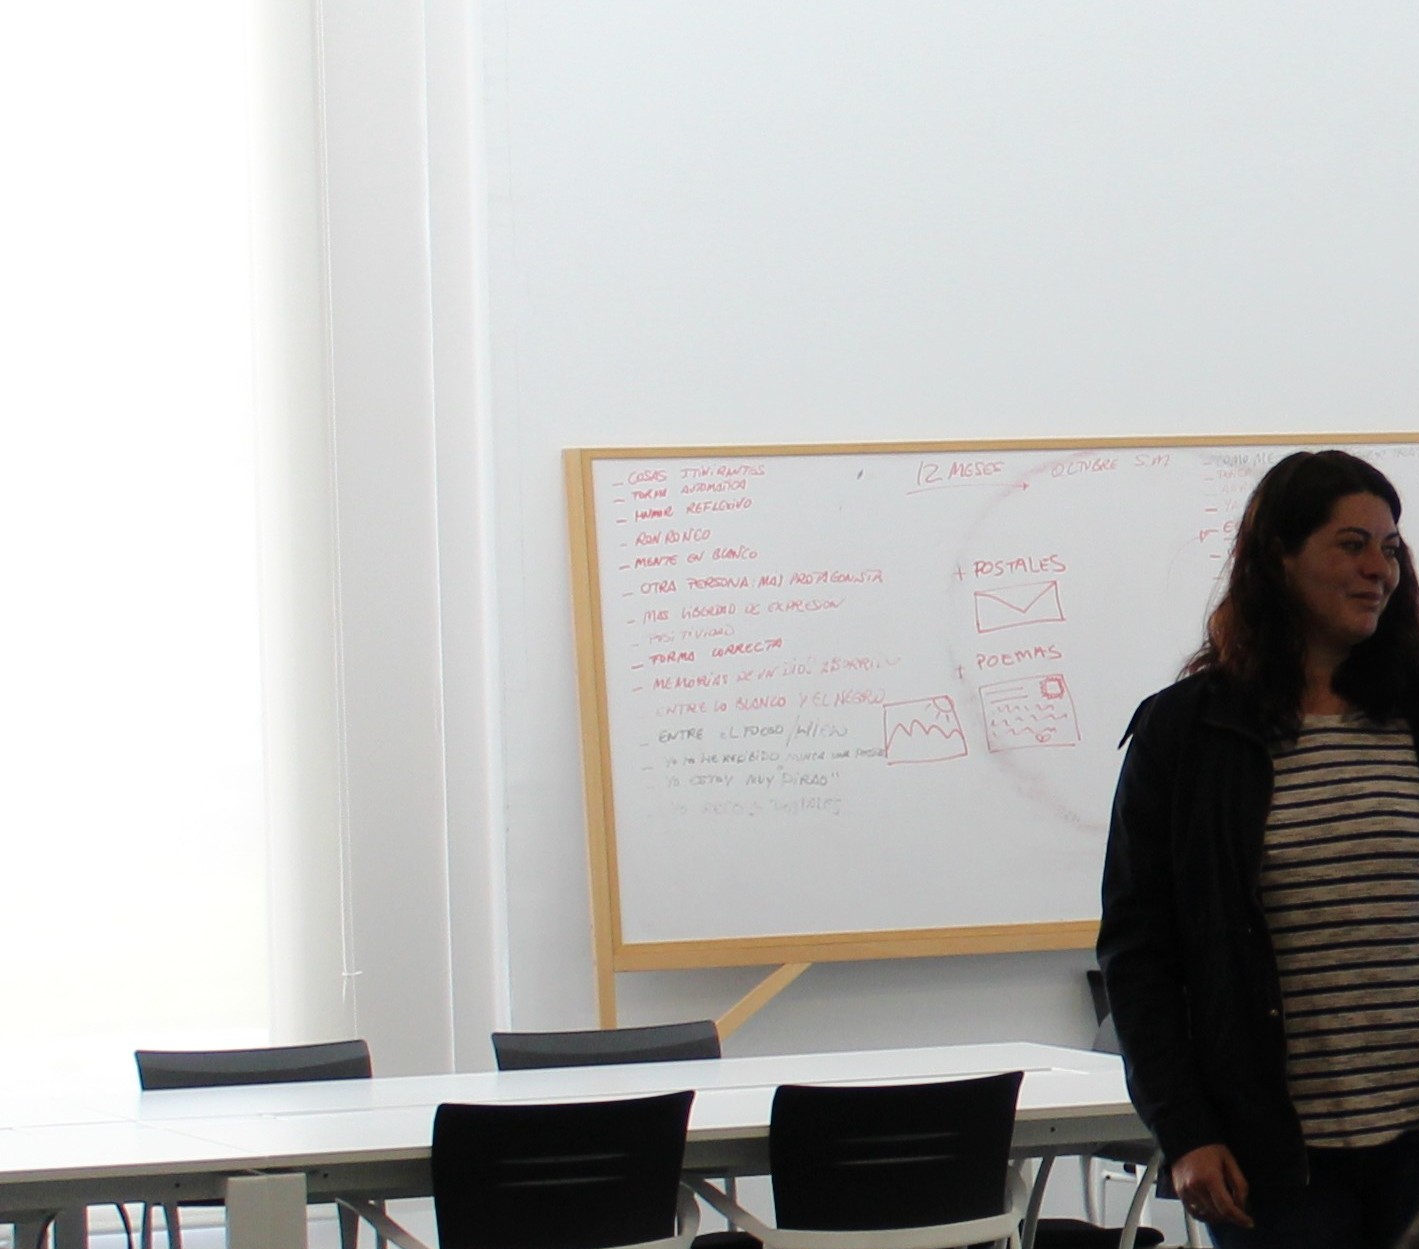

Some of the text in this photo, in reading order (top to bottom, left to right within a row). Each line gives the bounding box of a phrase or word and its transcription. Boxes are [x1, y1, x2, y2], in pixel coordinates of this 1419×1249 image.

[917, 460, 943, 485] 12
[974, 554, 1067, 577] POSTALES
[977, 645, 1063, 670] POEMAS
